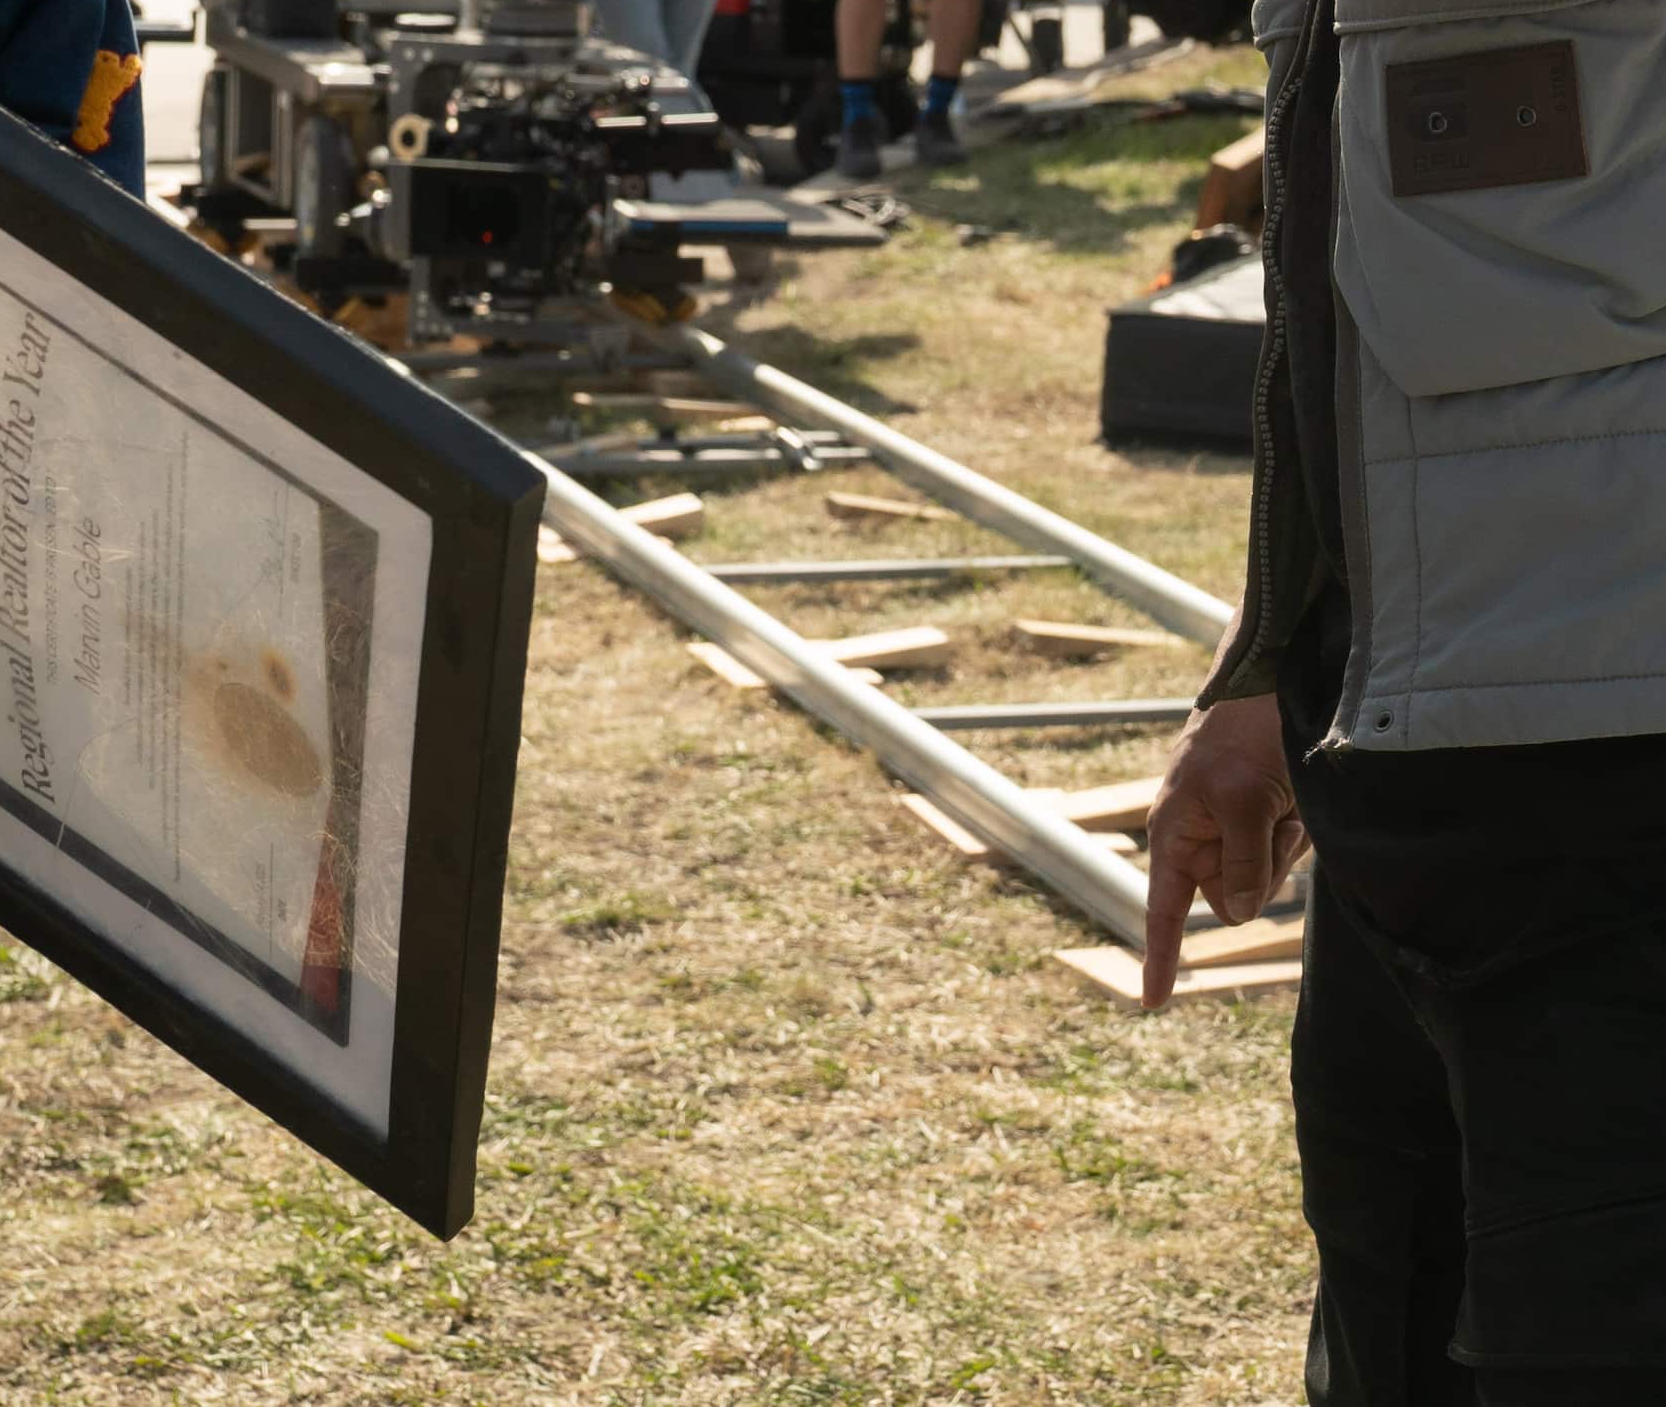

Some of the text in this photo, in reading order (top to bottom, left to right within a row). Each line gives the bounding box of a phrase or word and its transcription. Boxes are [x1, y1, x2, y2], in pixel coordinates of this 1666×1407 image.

[2, 312, 51, 396] Year
[45, 583, 57, 659] CERTIFICATE
[72, 516, 101, 695] Marvin Gable
